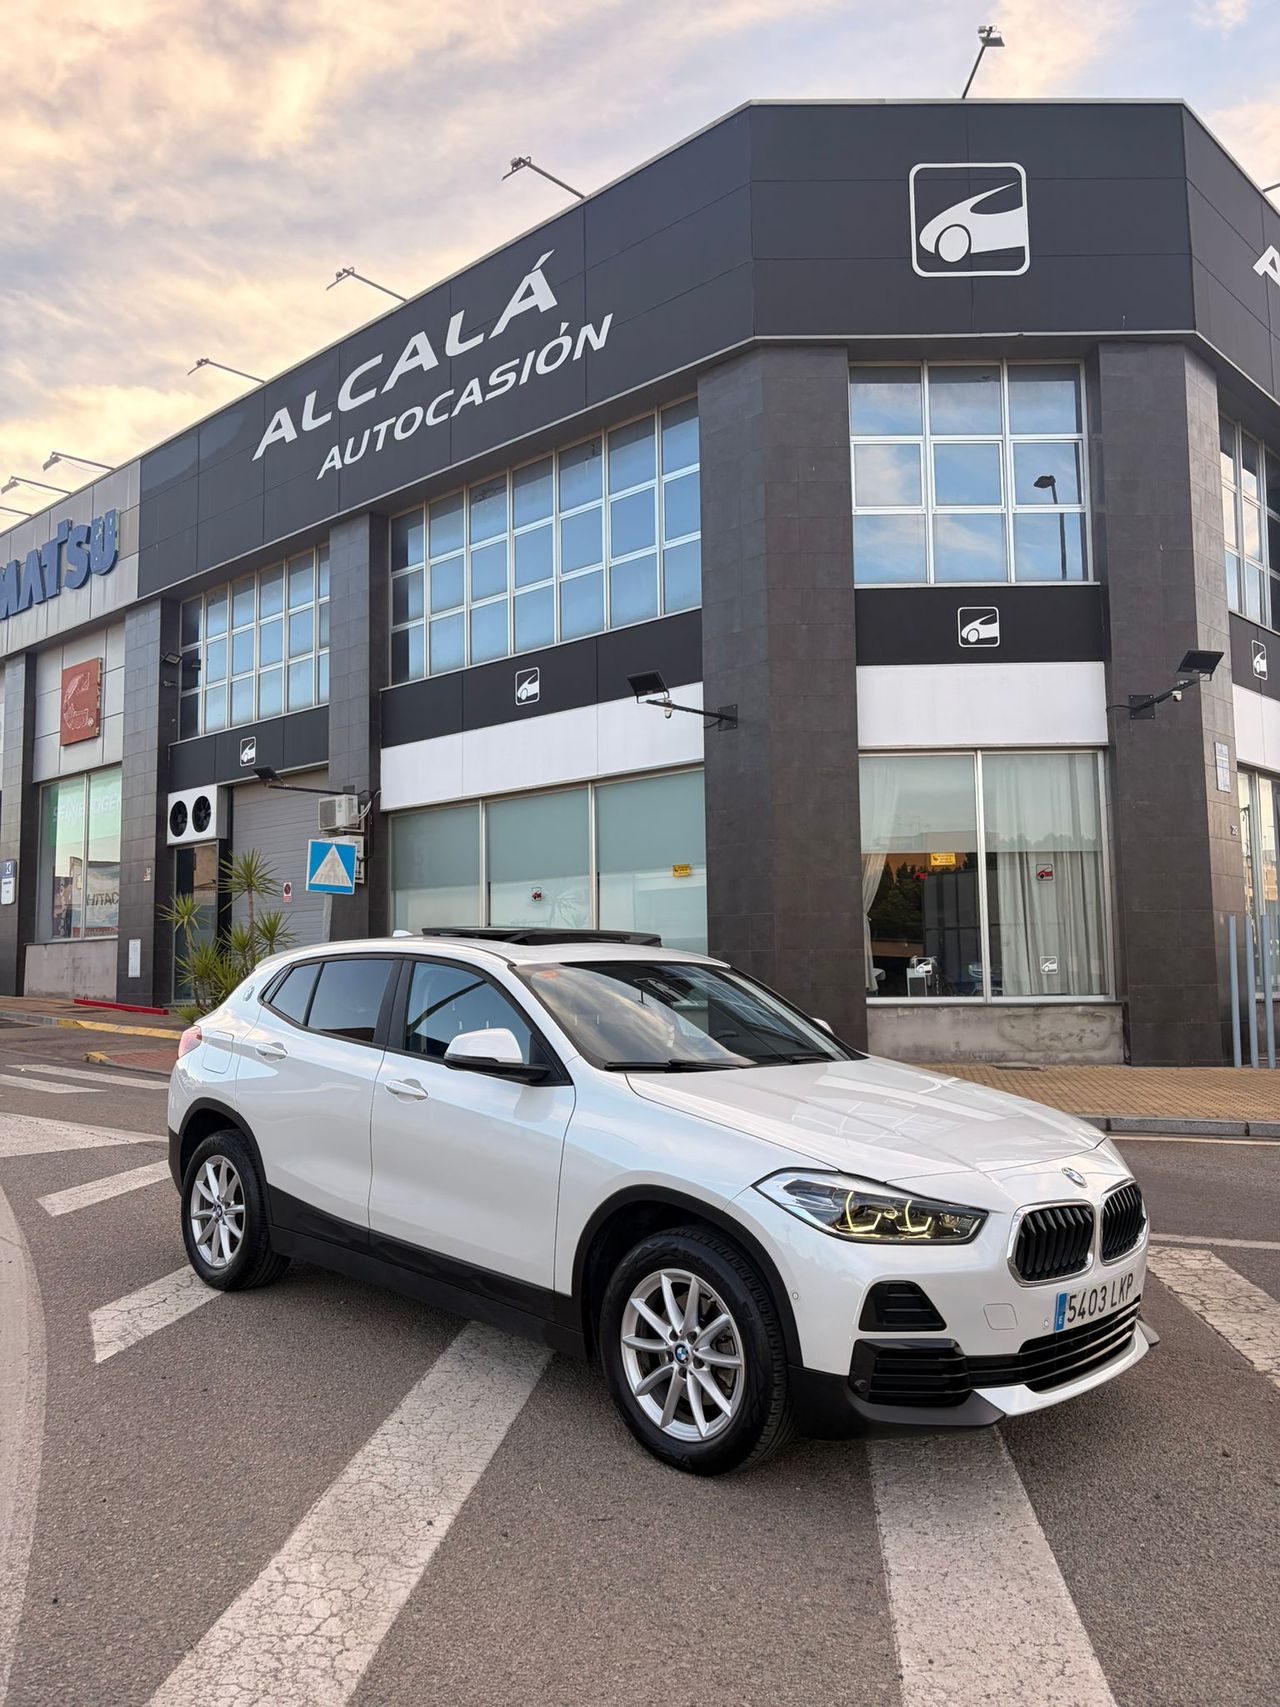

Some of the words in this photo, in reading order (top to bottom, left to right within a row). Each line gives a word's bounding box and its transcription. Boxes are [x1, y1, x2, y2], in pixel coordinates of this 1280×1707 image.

[252, 248, 558, 462] ALCALÁ
[316, 313, 613, 481] AUTOCASIÓN
[1068, 1286, 1107, 1323] 5403
[1110, 1273, 1133, 1307] LKP
